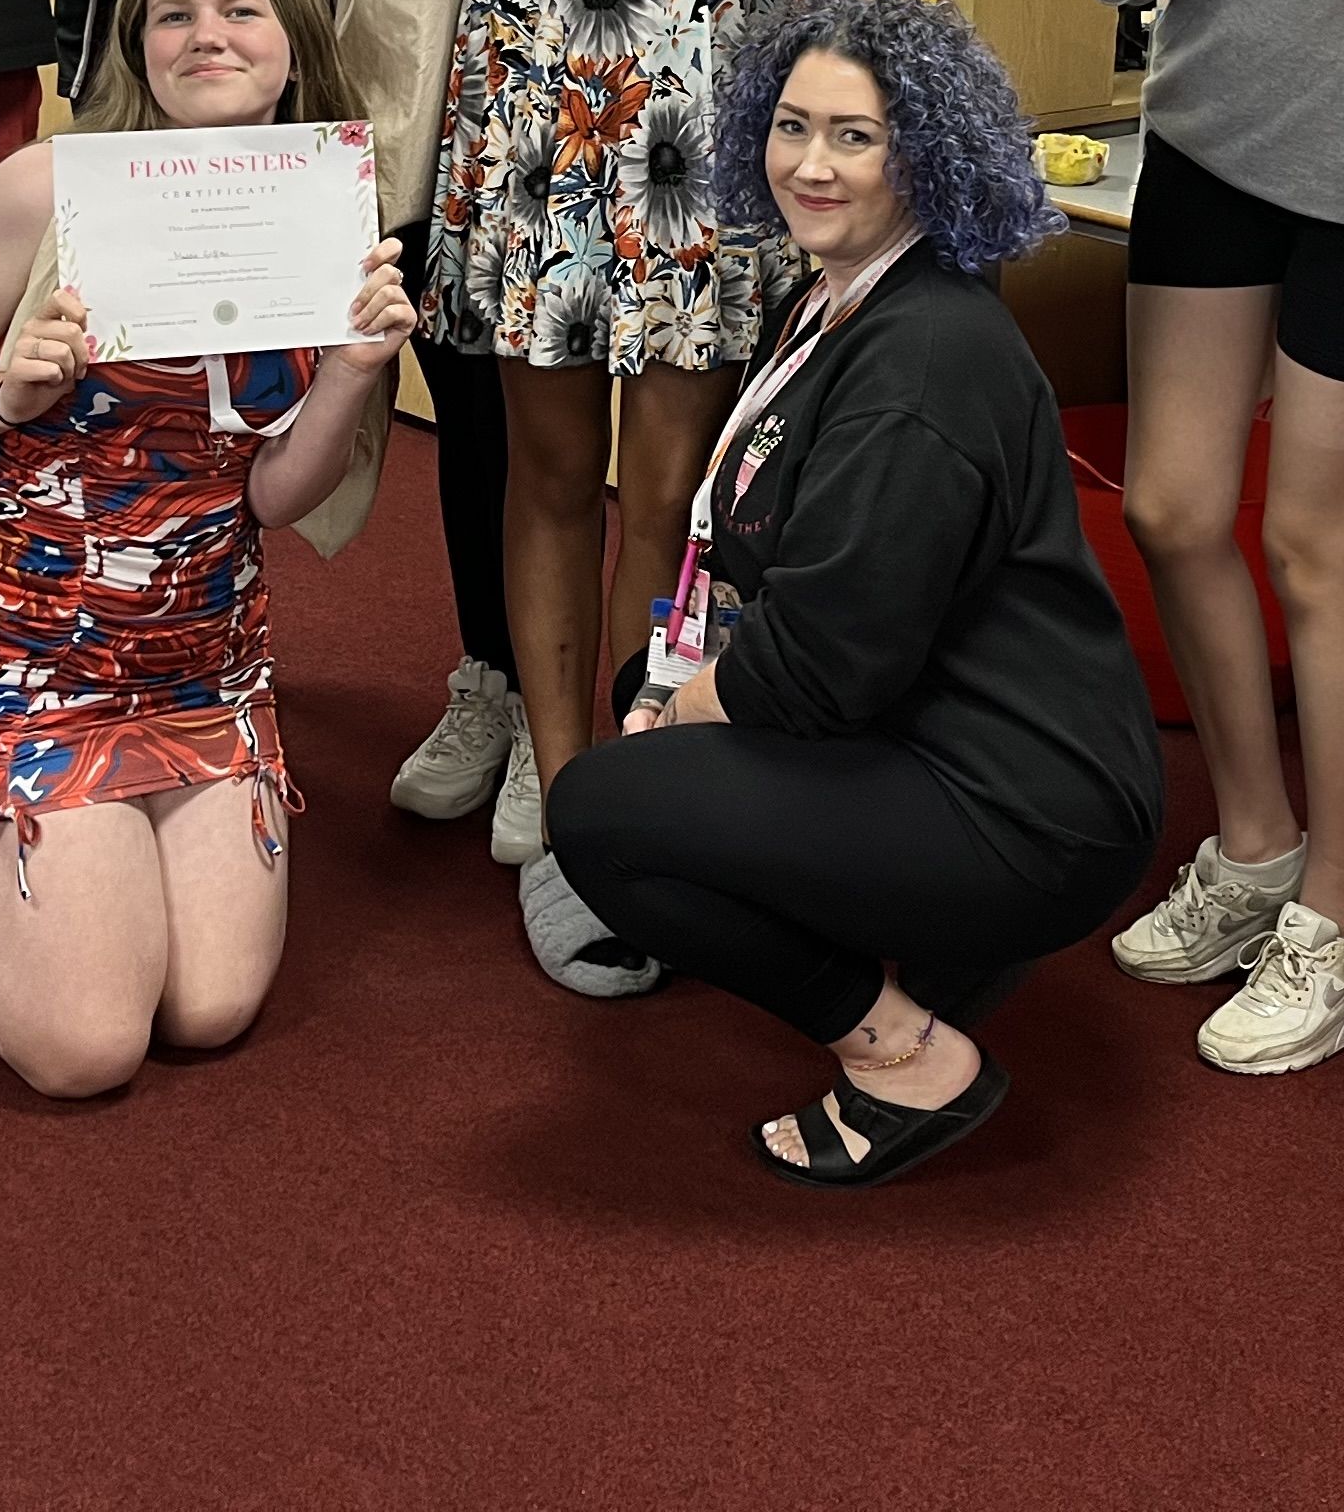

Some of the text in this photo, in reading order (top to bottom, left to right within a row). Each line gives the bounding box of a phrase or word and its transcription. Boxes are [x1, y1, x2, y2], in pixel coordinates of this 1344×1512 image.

[128, 151, 309, 180] FLOW SISTERS
[162, 185, 277, 199] CERTIFICATE
